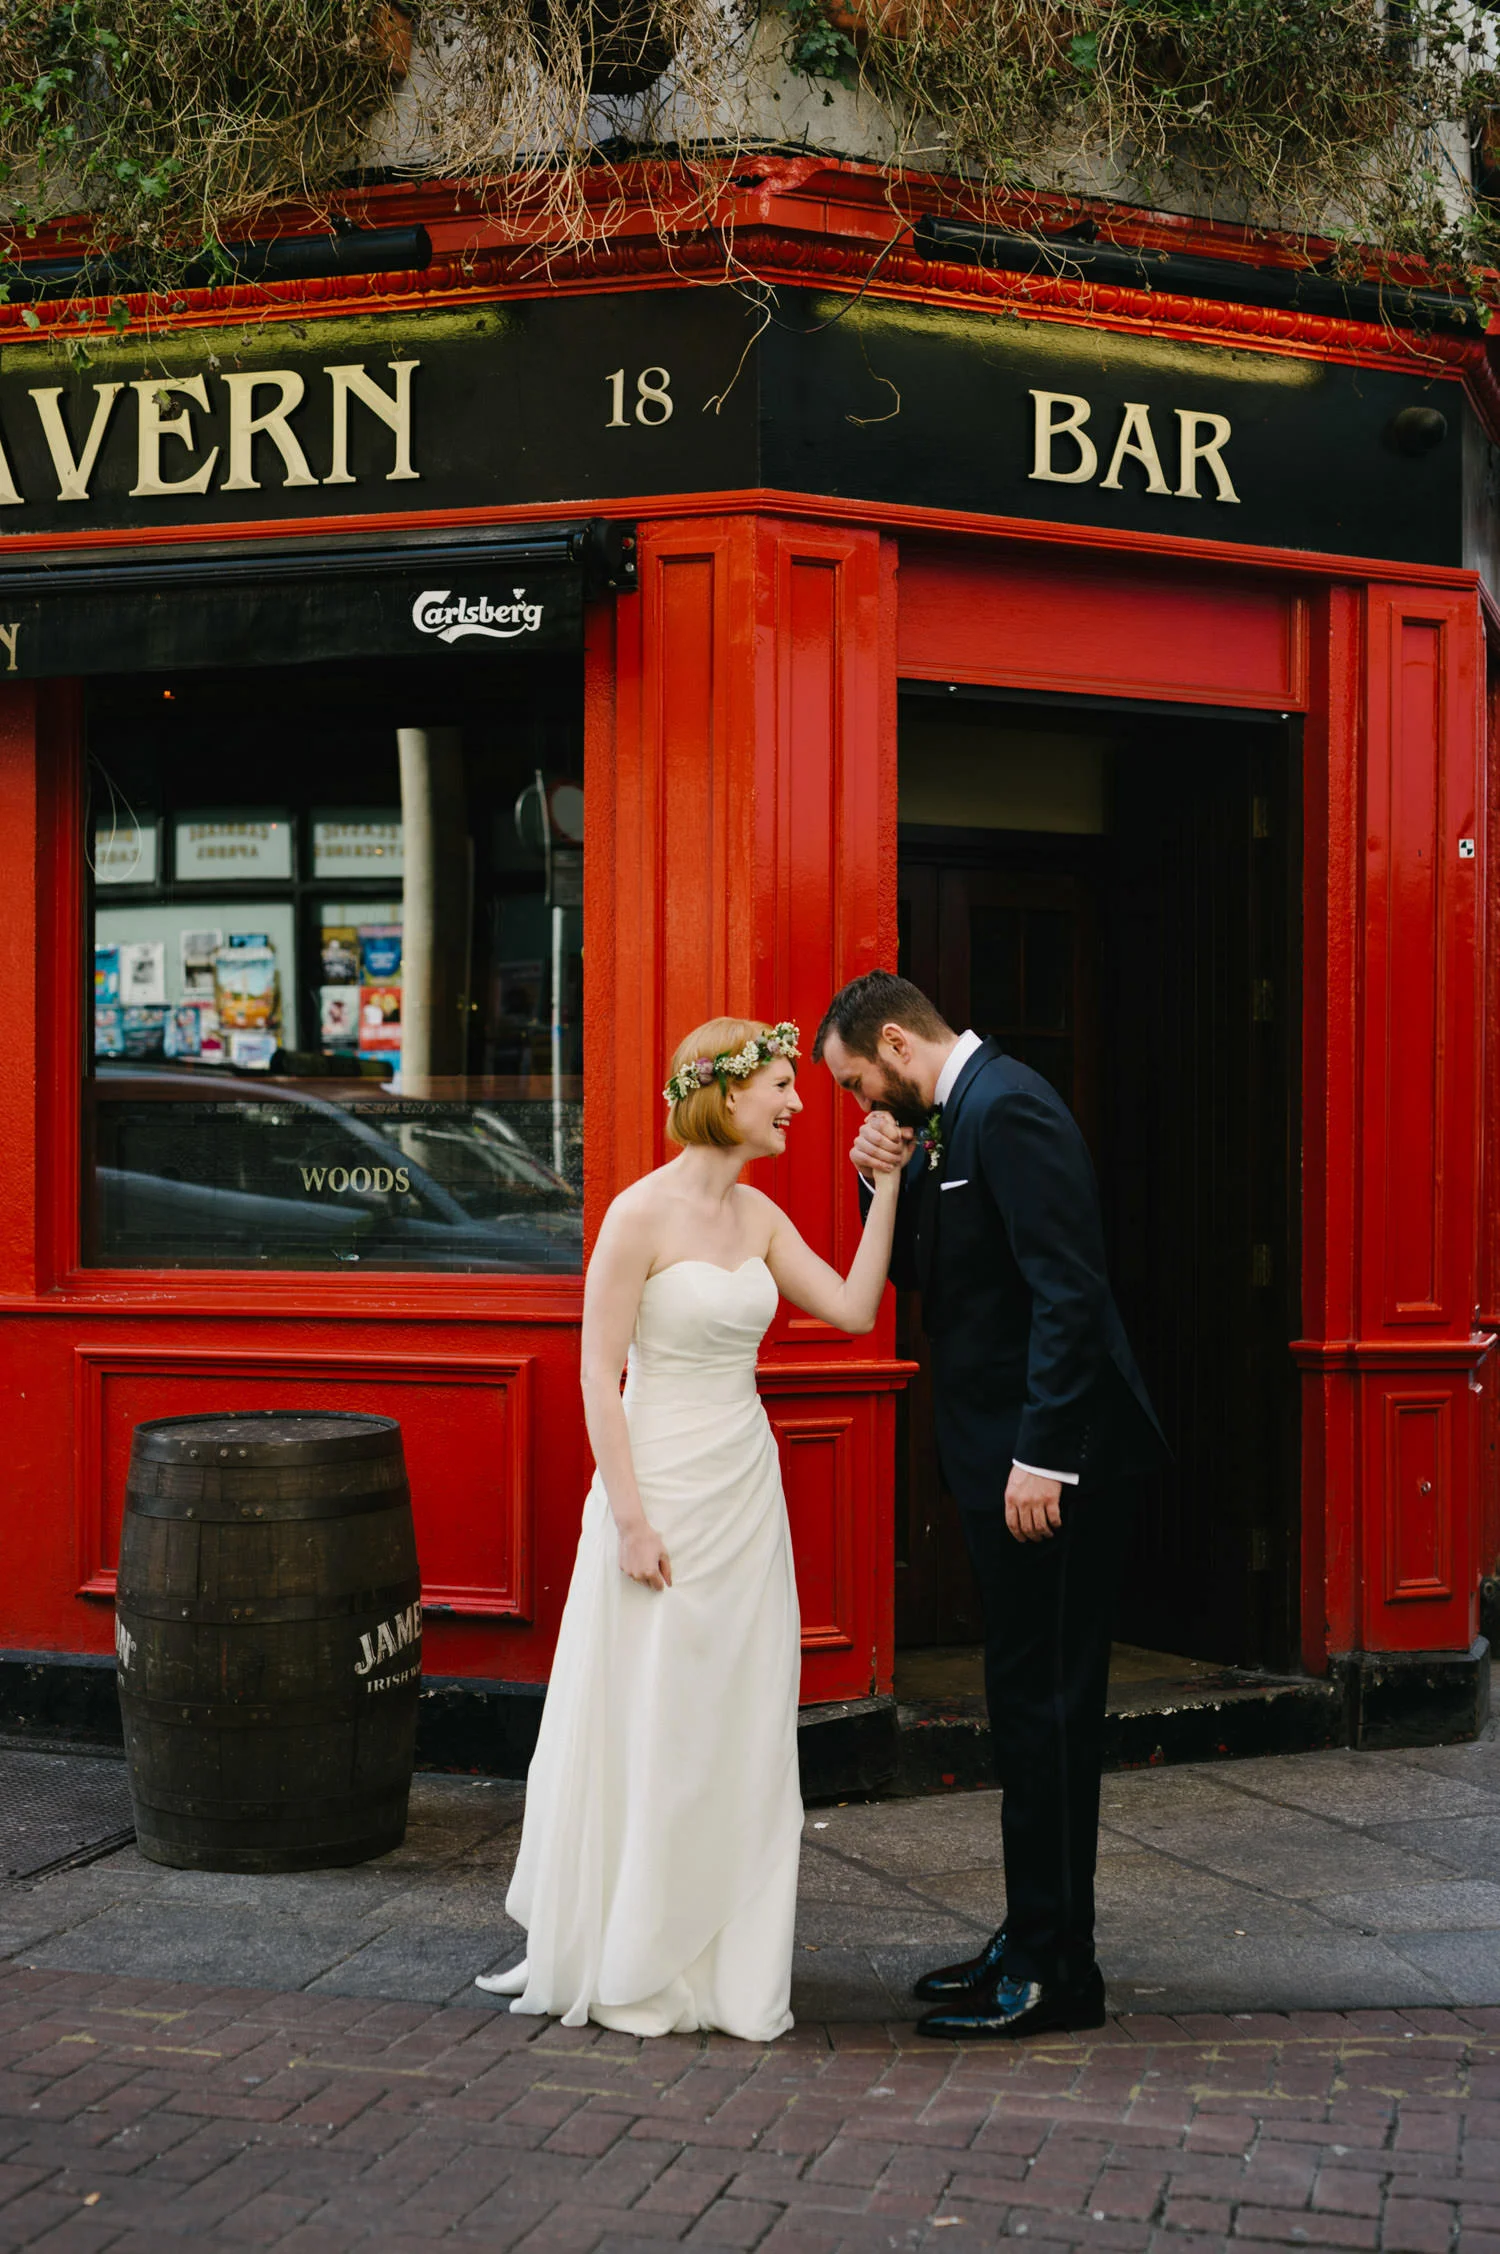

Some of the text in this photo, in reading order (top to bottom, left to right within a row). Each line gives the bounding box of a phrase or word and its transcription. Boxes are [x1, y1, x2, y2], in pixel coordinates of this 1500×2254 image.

[605, 366, 674, 428] 18
[0, 360, 421, 505] VERN
[1028, 389, 1241, 503] BAR
[412, 588, 544, 643] Carlsberg
[300, 1166, 410, 1193] WOODS
[367, 1670, 409, 1693] IRISH
